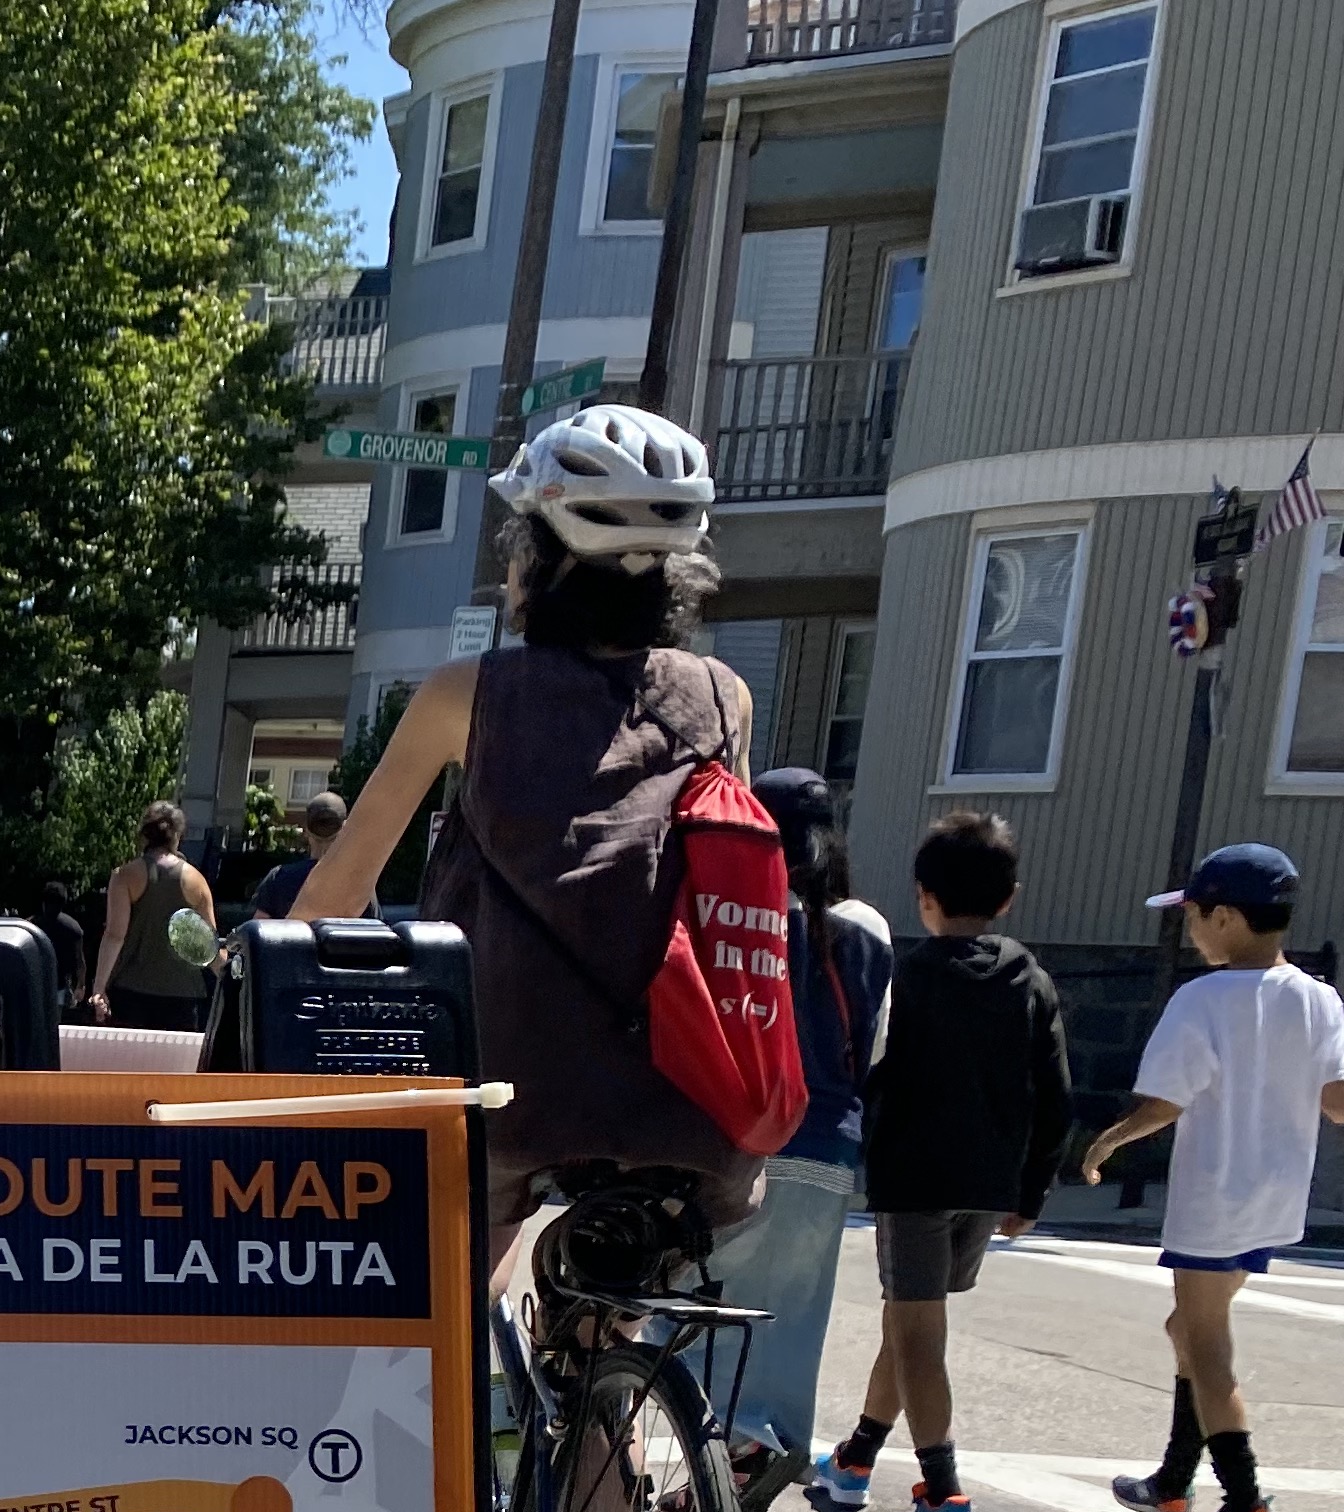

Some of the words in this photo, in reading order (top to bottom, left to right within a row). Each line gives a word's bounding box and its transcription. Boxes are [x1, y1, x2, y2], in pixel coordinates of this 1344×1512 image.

[360, 433, 448, 465] GROVENOR
[462, 451, 478, 466] RD
[714, 940, 744, 971] in
[751, 948, 787, 981] the
[213, 1159, 391, 1220] MAP
[43, 1237, 123, 1284] DE
[144, 1238, 224, 1284] LA
[238, 1239, 396, 1286] RUTA
[124, 1425, 252, 1447] JACKSON
[261, 1426, 298, 1450] SQ
